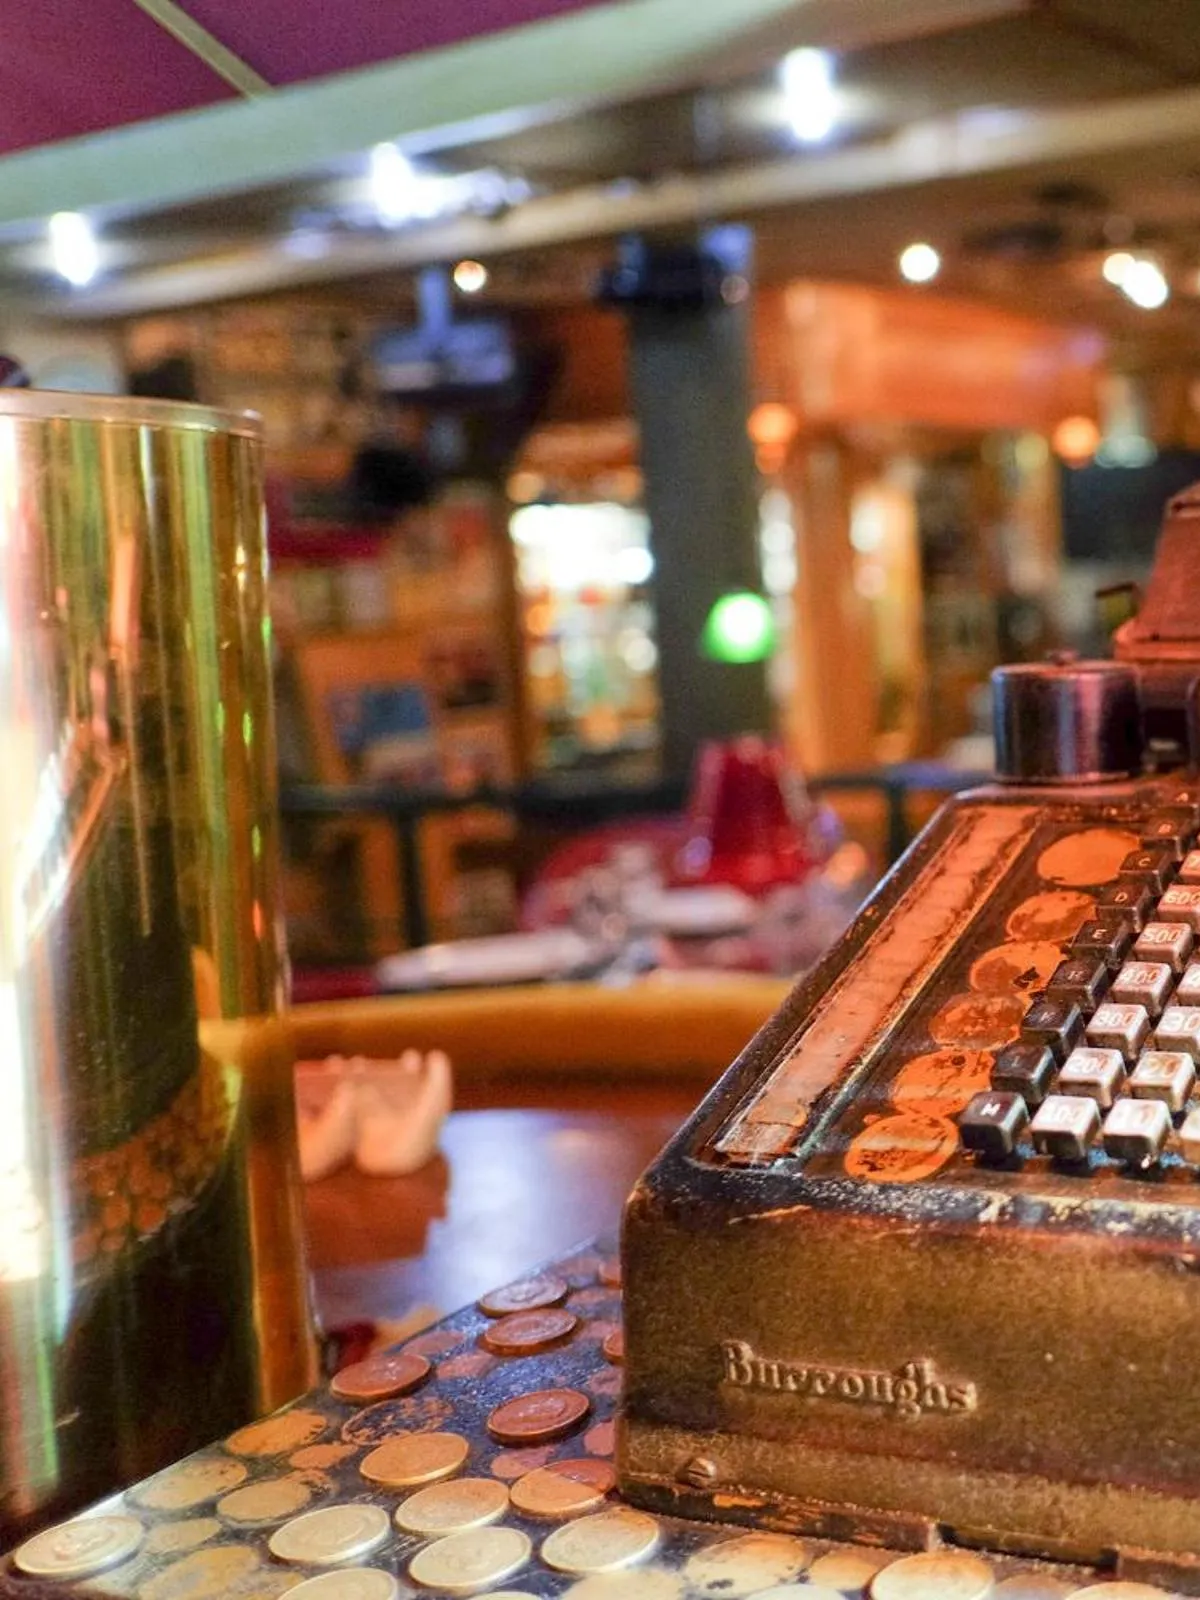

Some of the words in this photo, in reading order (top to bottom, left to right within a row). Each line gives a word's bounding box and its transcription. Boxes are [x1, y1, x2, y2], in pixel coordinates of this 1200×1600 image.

[1114, 892, 1128, 903] D
[1092, 929, 1106, 939] E
[1142, 929, 1180, 944] 500
[1120, 969, 1160, 985] 400
[1097, 1010, 1137, 1028] 300
[980, 1103, 1001, 1116] M
[720, 1338, 978, 1421] Burroughs
